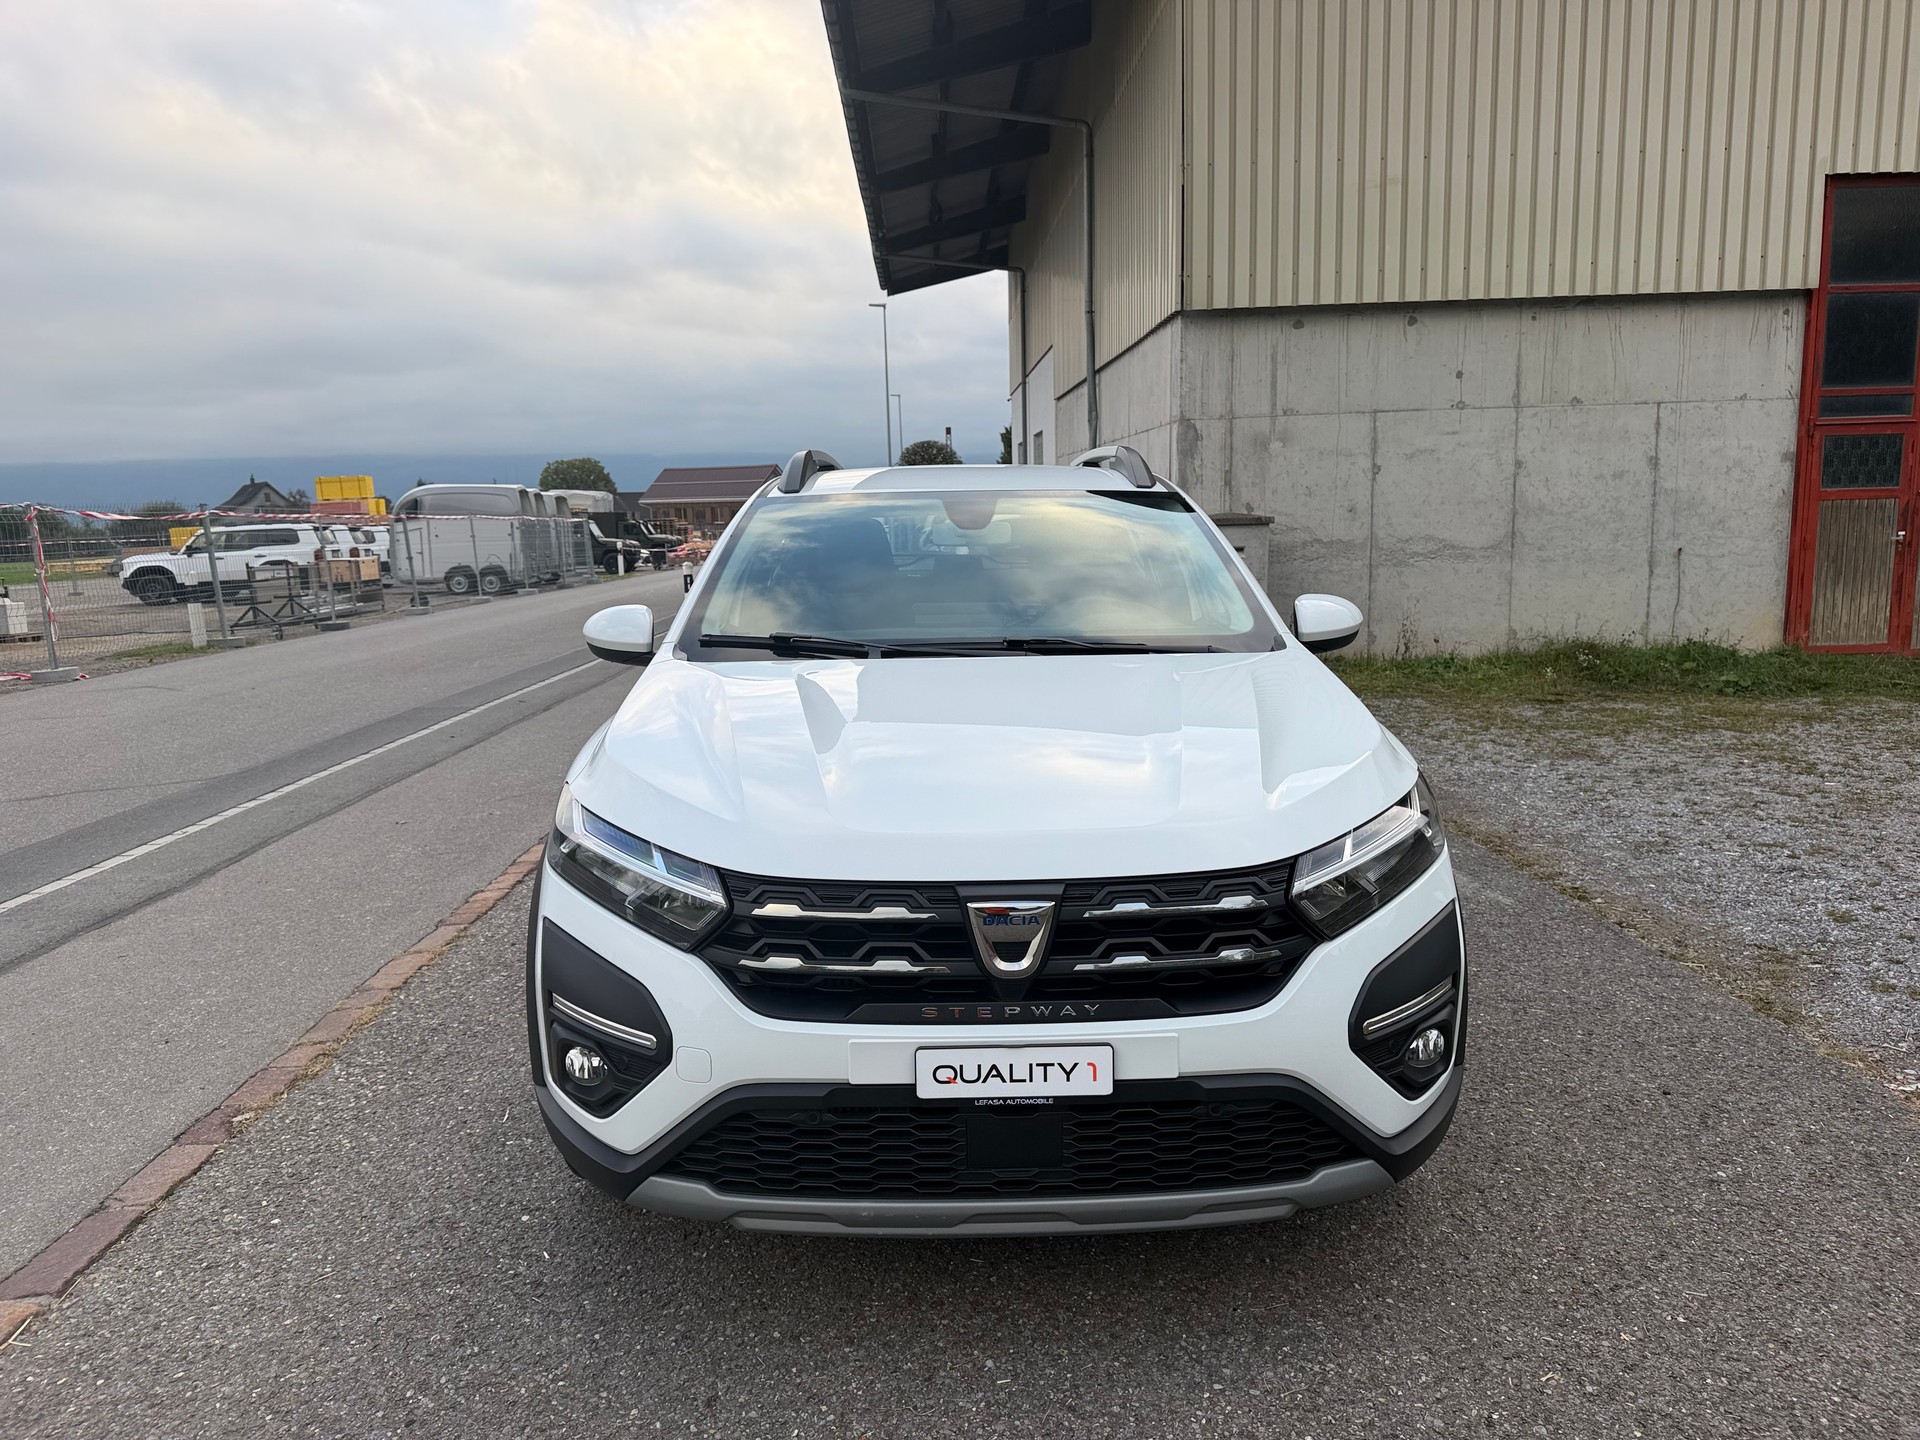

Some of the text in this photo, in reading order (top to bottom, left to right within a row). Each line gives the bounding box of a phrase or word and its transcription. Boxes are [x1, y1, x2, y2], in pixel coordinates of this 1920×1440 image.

[982, 915, 1040, 926] DACIA
[921, 1004, 1100, 1018] STEPWAY
[932, 1061, 1098, 1084] QUALITY 1
[1005, 1097, 1054, 1105] AUTOMOBILE
